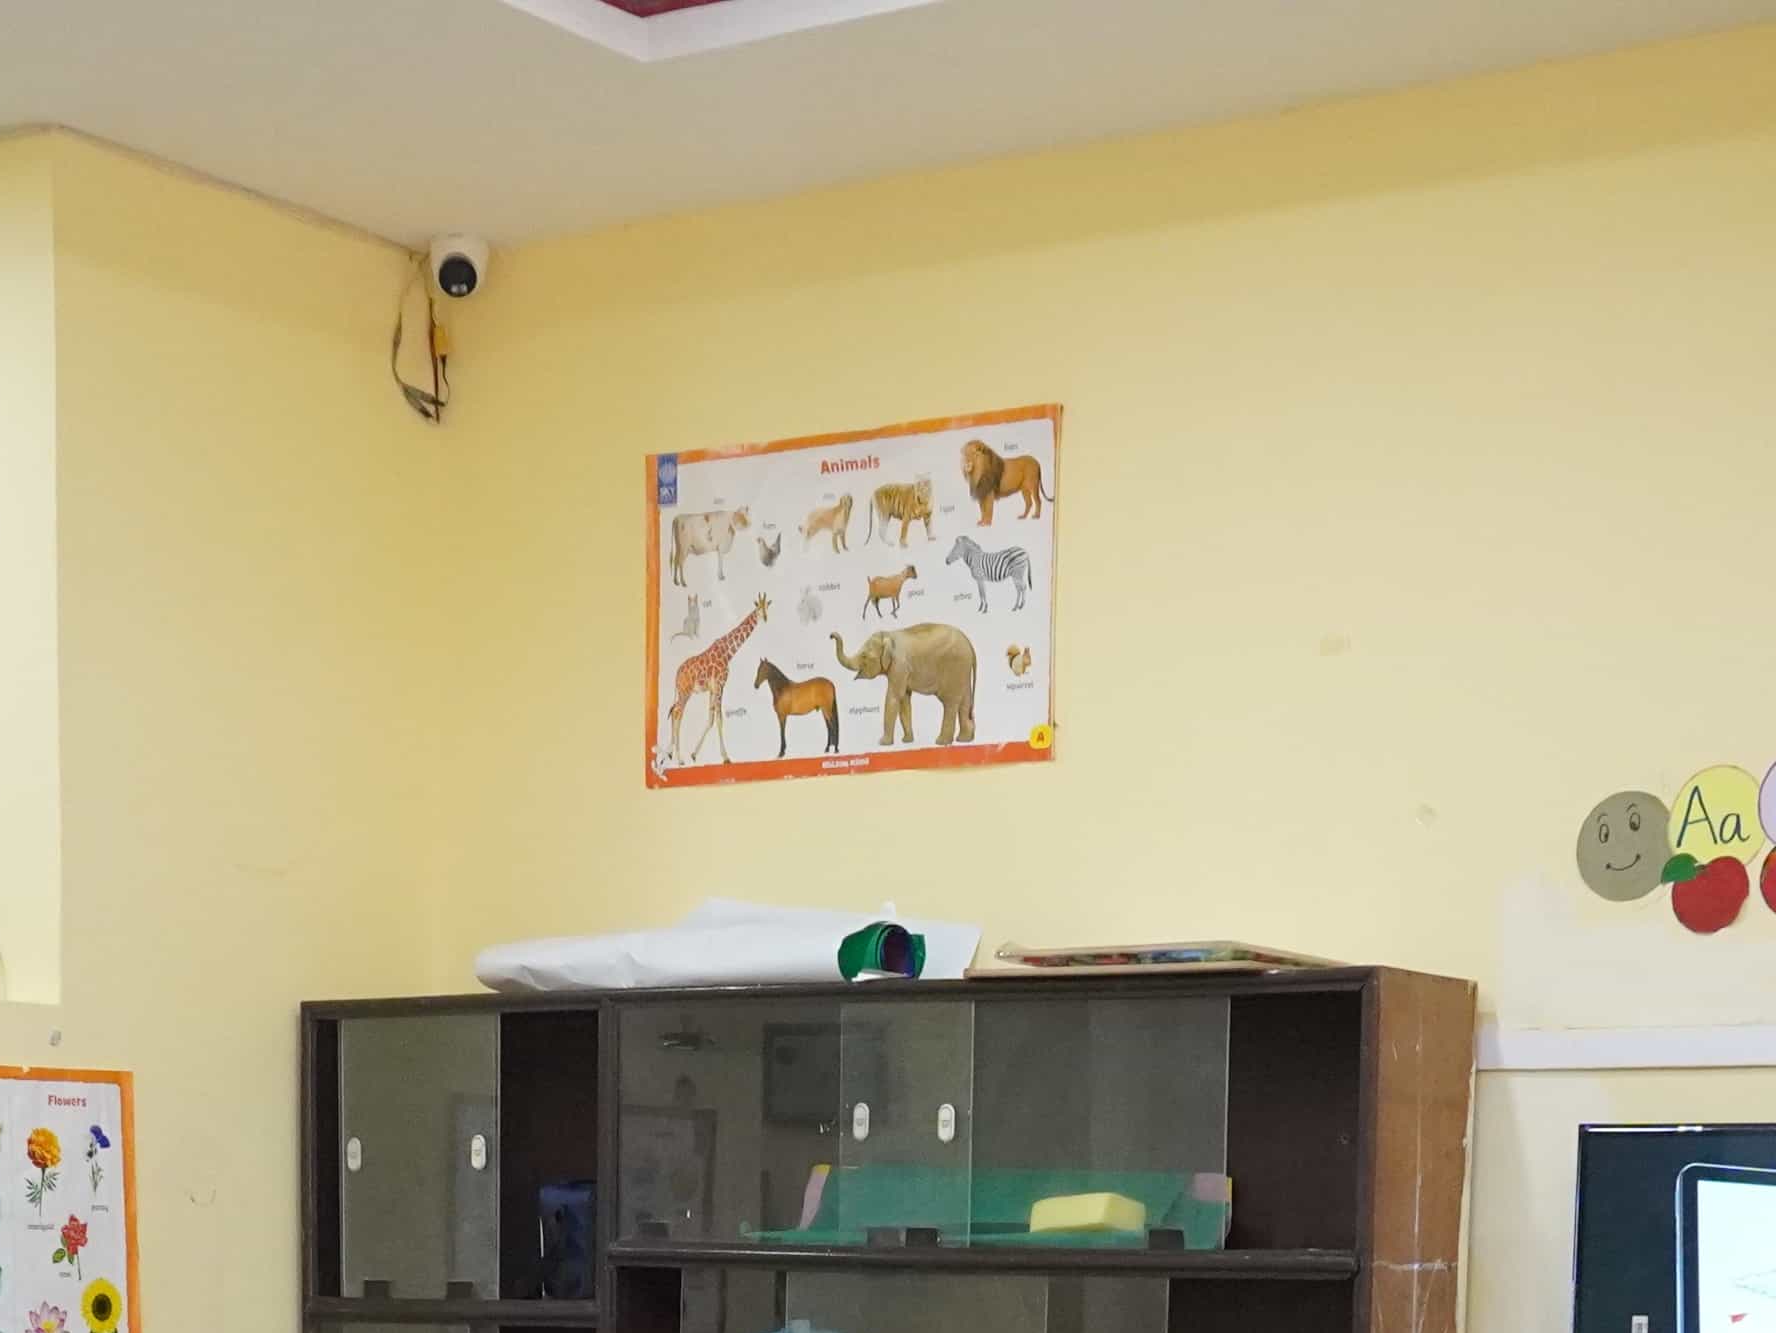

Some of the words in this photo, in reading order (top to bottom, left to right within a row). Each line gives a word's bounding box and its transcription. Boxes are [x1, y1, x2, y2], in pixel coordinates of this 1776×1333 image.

[820, 455, 880, 474] Animals
[1036, 732, 1044, 743] A
[1675, 784, 1751, 848] Aa
[48, 1094, 87, 1107] Flowers
